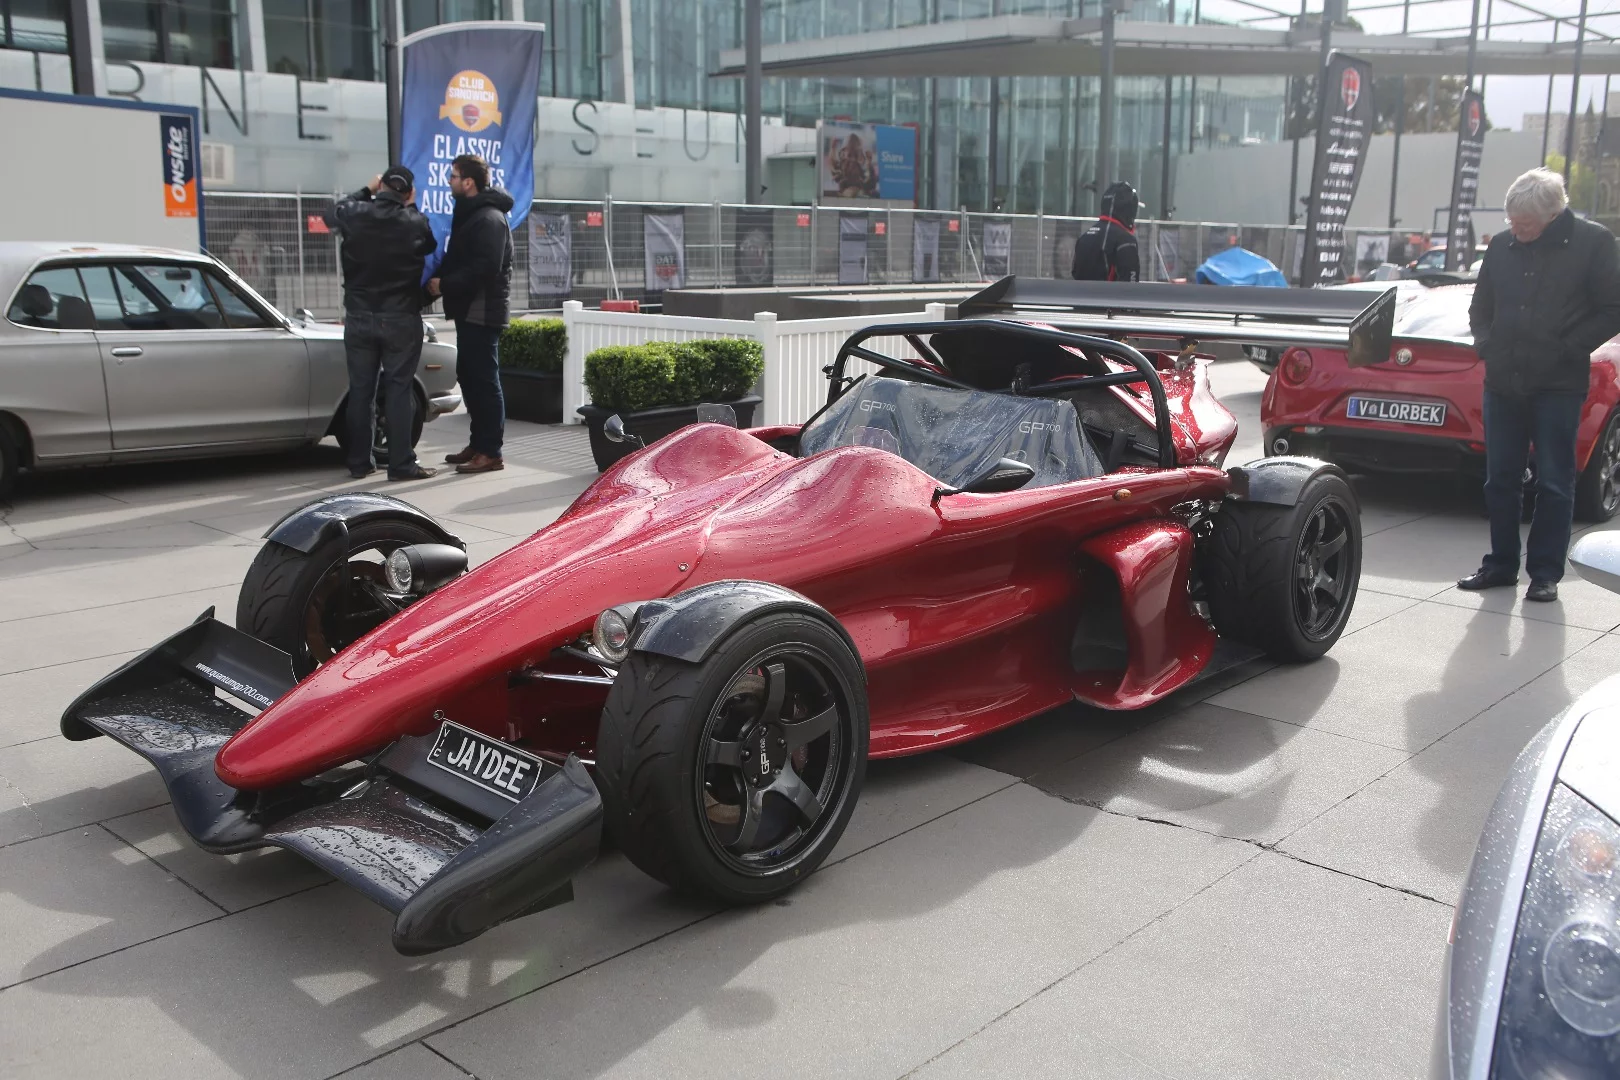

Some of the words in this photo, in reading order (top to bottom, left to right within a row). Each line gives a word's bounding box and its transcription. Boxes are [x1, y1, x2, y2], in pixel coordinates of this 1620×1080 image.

[449, 87, 495, 103] SANDWICH
[459, 76, 485, 91] CLUB
[433, 134, 502, 165] CLASSIC
[1379, 402, 1441, 423] LORBEK
[195, 662, 275, 707] www.quantumgp700.com.a
[433, 728, 451, 757] VIC
[447, 736, 531, 795] JAYDEE
